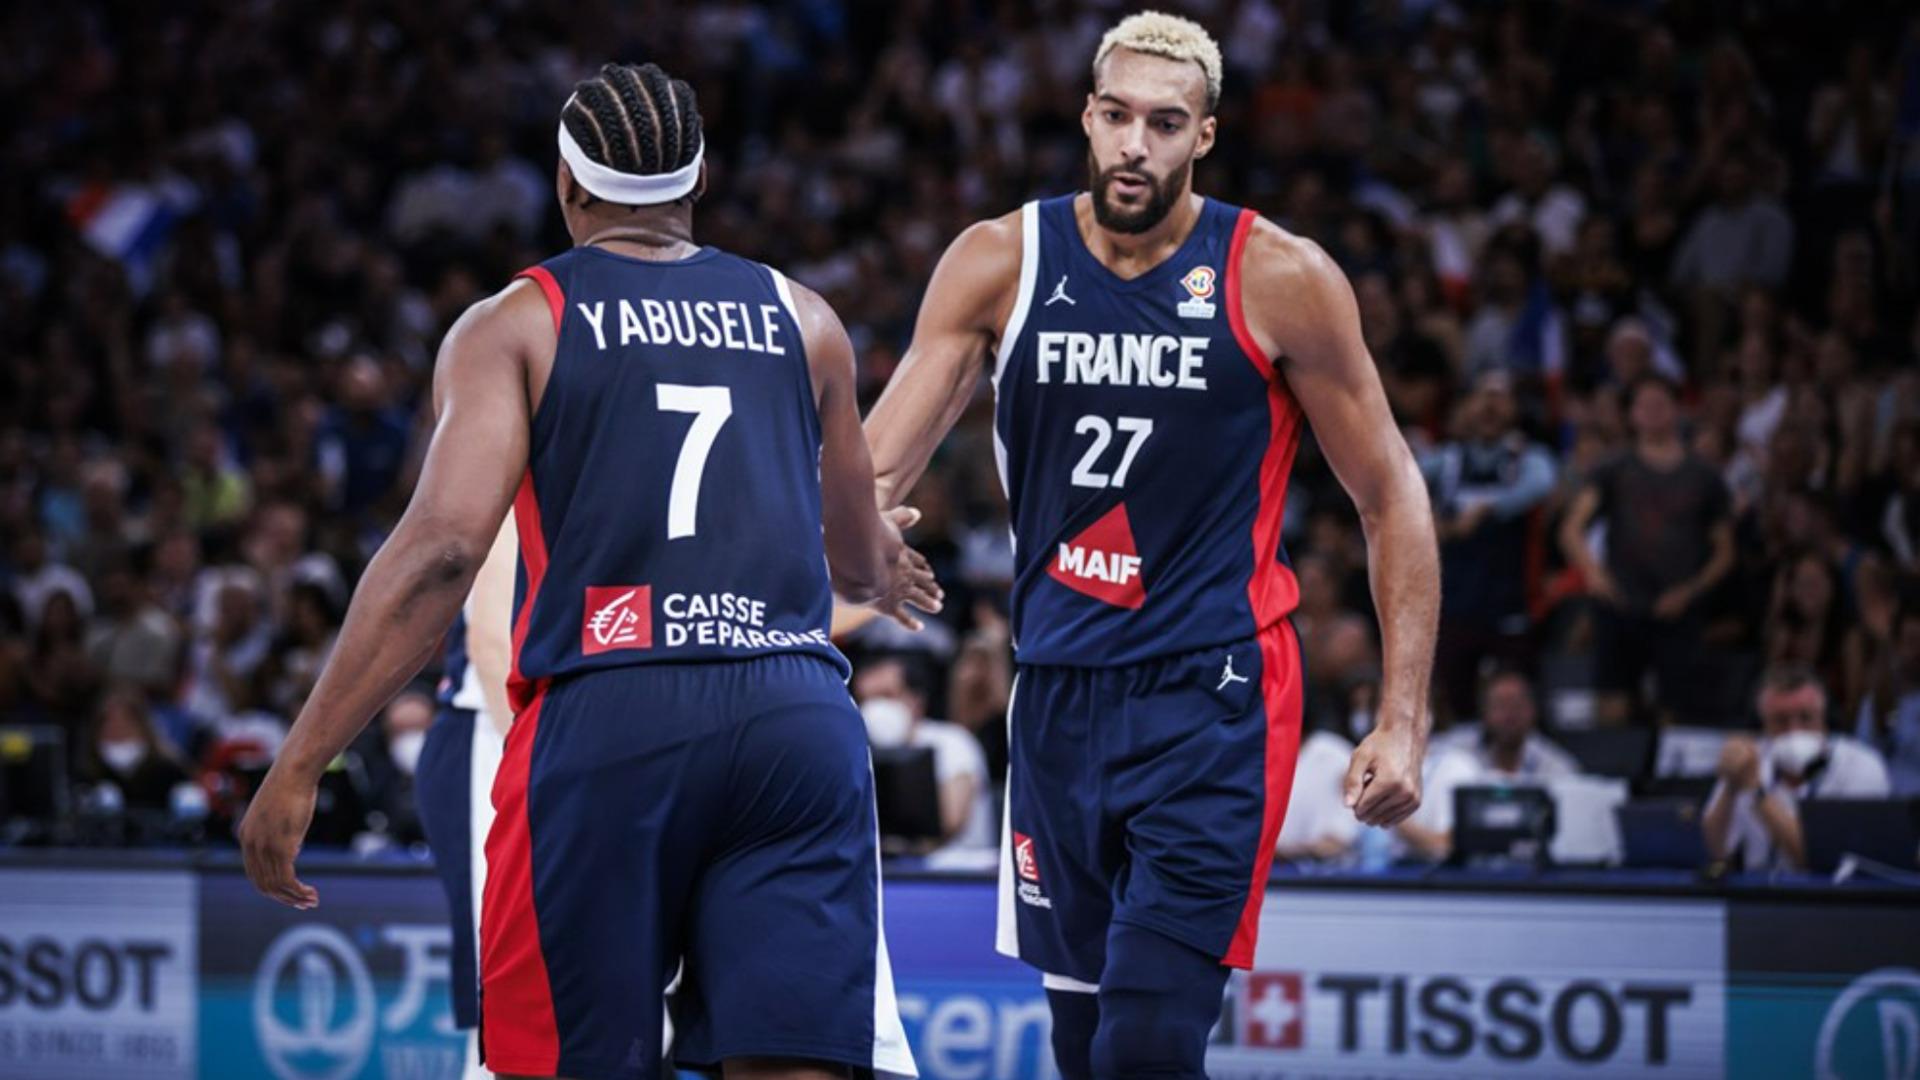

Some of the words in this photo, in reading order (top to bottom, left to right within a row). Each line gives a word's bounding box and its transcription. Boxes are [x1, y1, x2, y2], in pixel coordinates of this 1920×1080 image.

[579, 299, 785, 356] YABUSELE
[1037, 331, 1210, 390] FRANCE
[656, 383, 732, 540] 7
[1071, 415, 1153, 488] 27
[1059, 543, 1142, 584] MAIF
[663, 592, 766, 627] CAISSE
[665, 620, 829, 648] D'EPARGNE
[1317, 974, 1692, 1066] TISSOT
